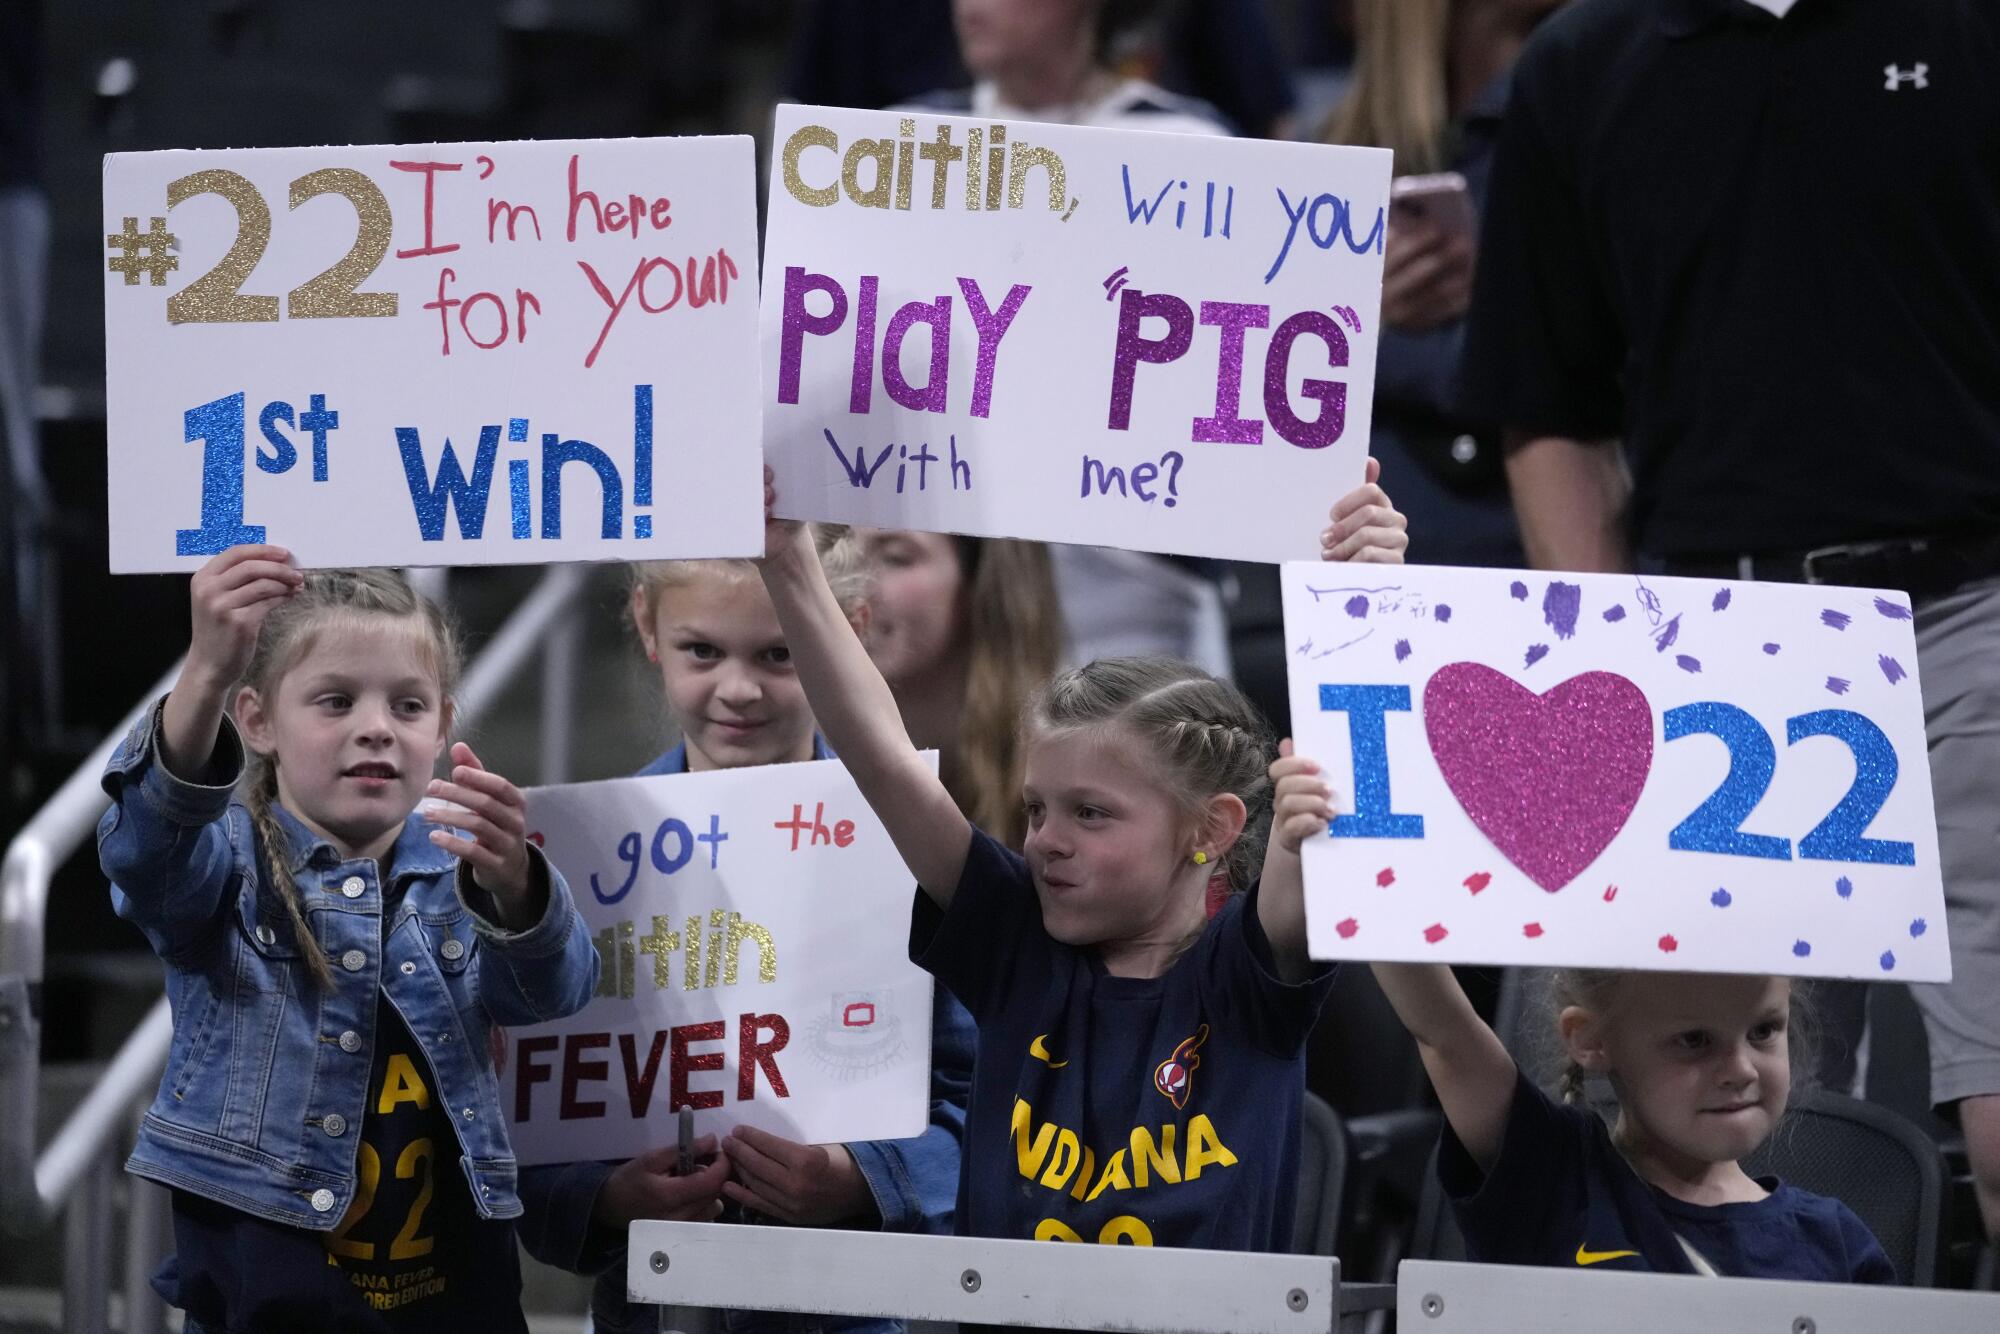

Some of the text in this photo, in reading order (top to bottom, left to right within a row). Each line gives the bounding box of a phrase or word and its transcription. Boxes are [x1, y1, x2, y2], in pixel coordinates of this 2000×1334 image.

[390, 156, 541, 258] I'm
[567, 155, 672, 241] here
[782, 118, 1079, 222] Caitlin,
[1265, 187, 1384, 284] you
[423, 248, 738, 367] for your
[176, 391, 338, 555] 1st
[1080, 451, 1183, 508] me?
[1318, 684, 1915, 866] I 22
[590, 802, 855, 904] got the
[515, 1012, 790, 1123] FEVER
[1009, 1094, 1238, 1202] NDIANA
